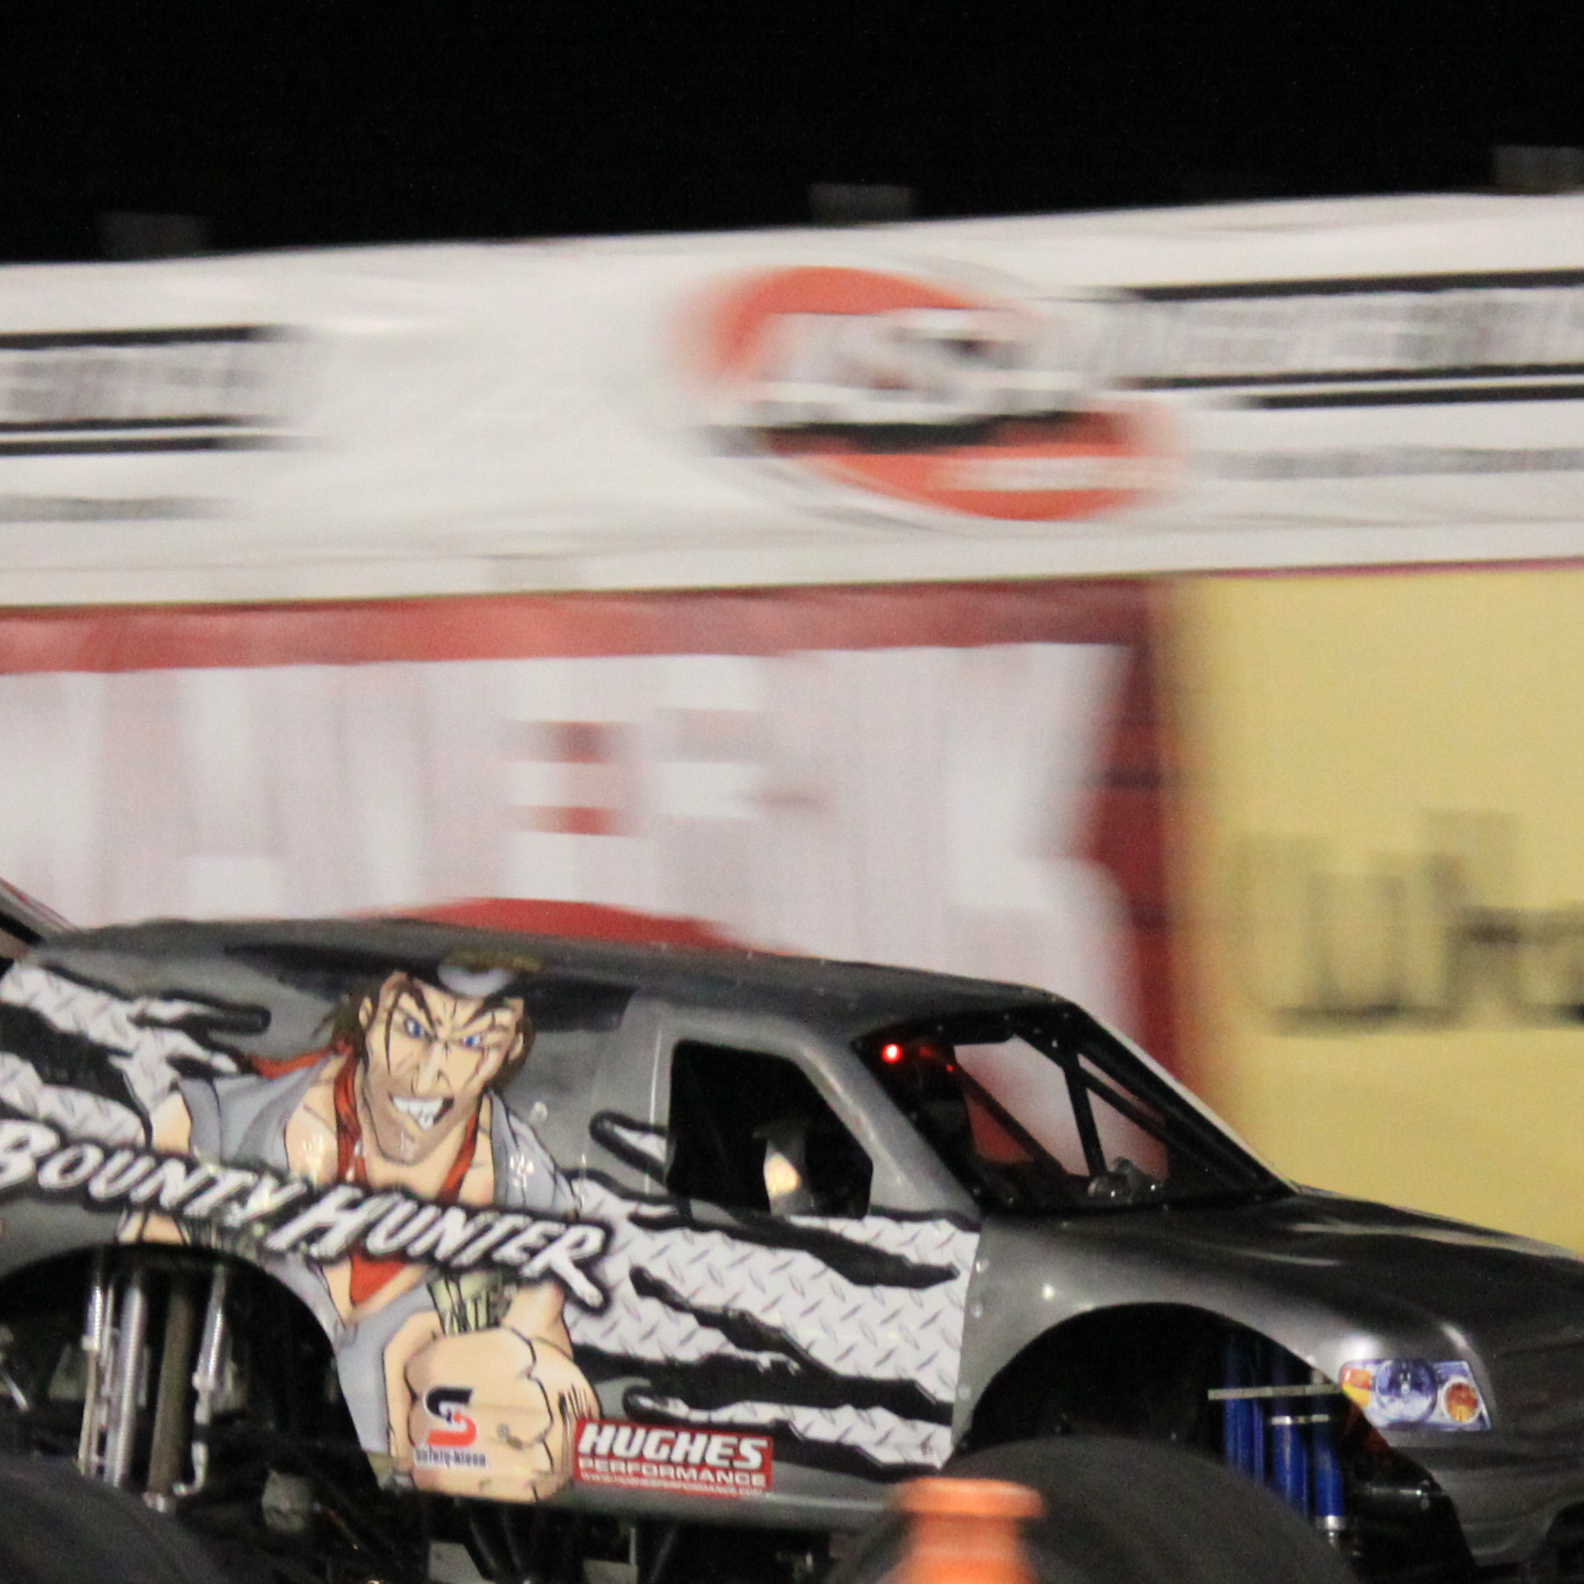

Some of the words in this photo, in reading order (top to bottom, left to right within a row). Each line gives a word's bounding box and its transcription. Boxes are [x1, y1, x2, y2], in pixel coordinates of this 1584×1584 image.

[268, 1184, 606, 1307] HUNTER
[578, 1423, 768, 1470] HUGHES
[578, 1456, 766, 1488] PERFORMANCE
